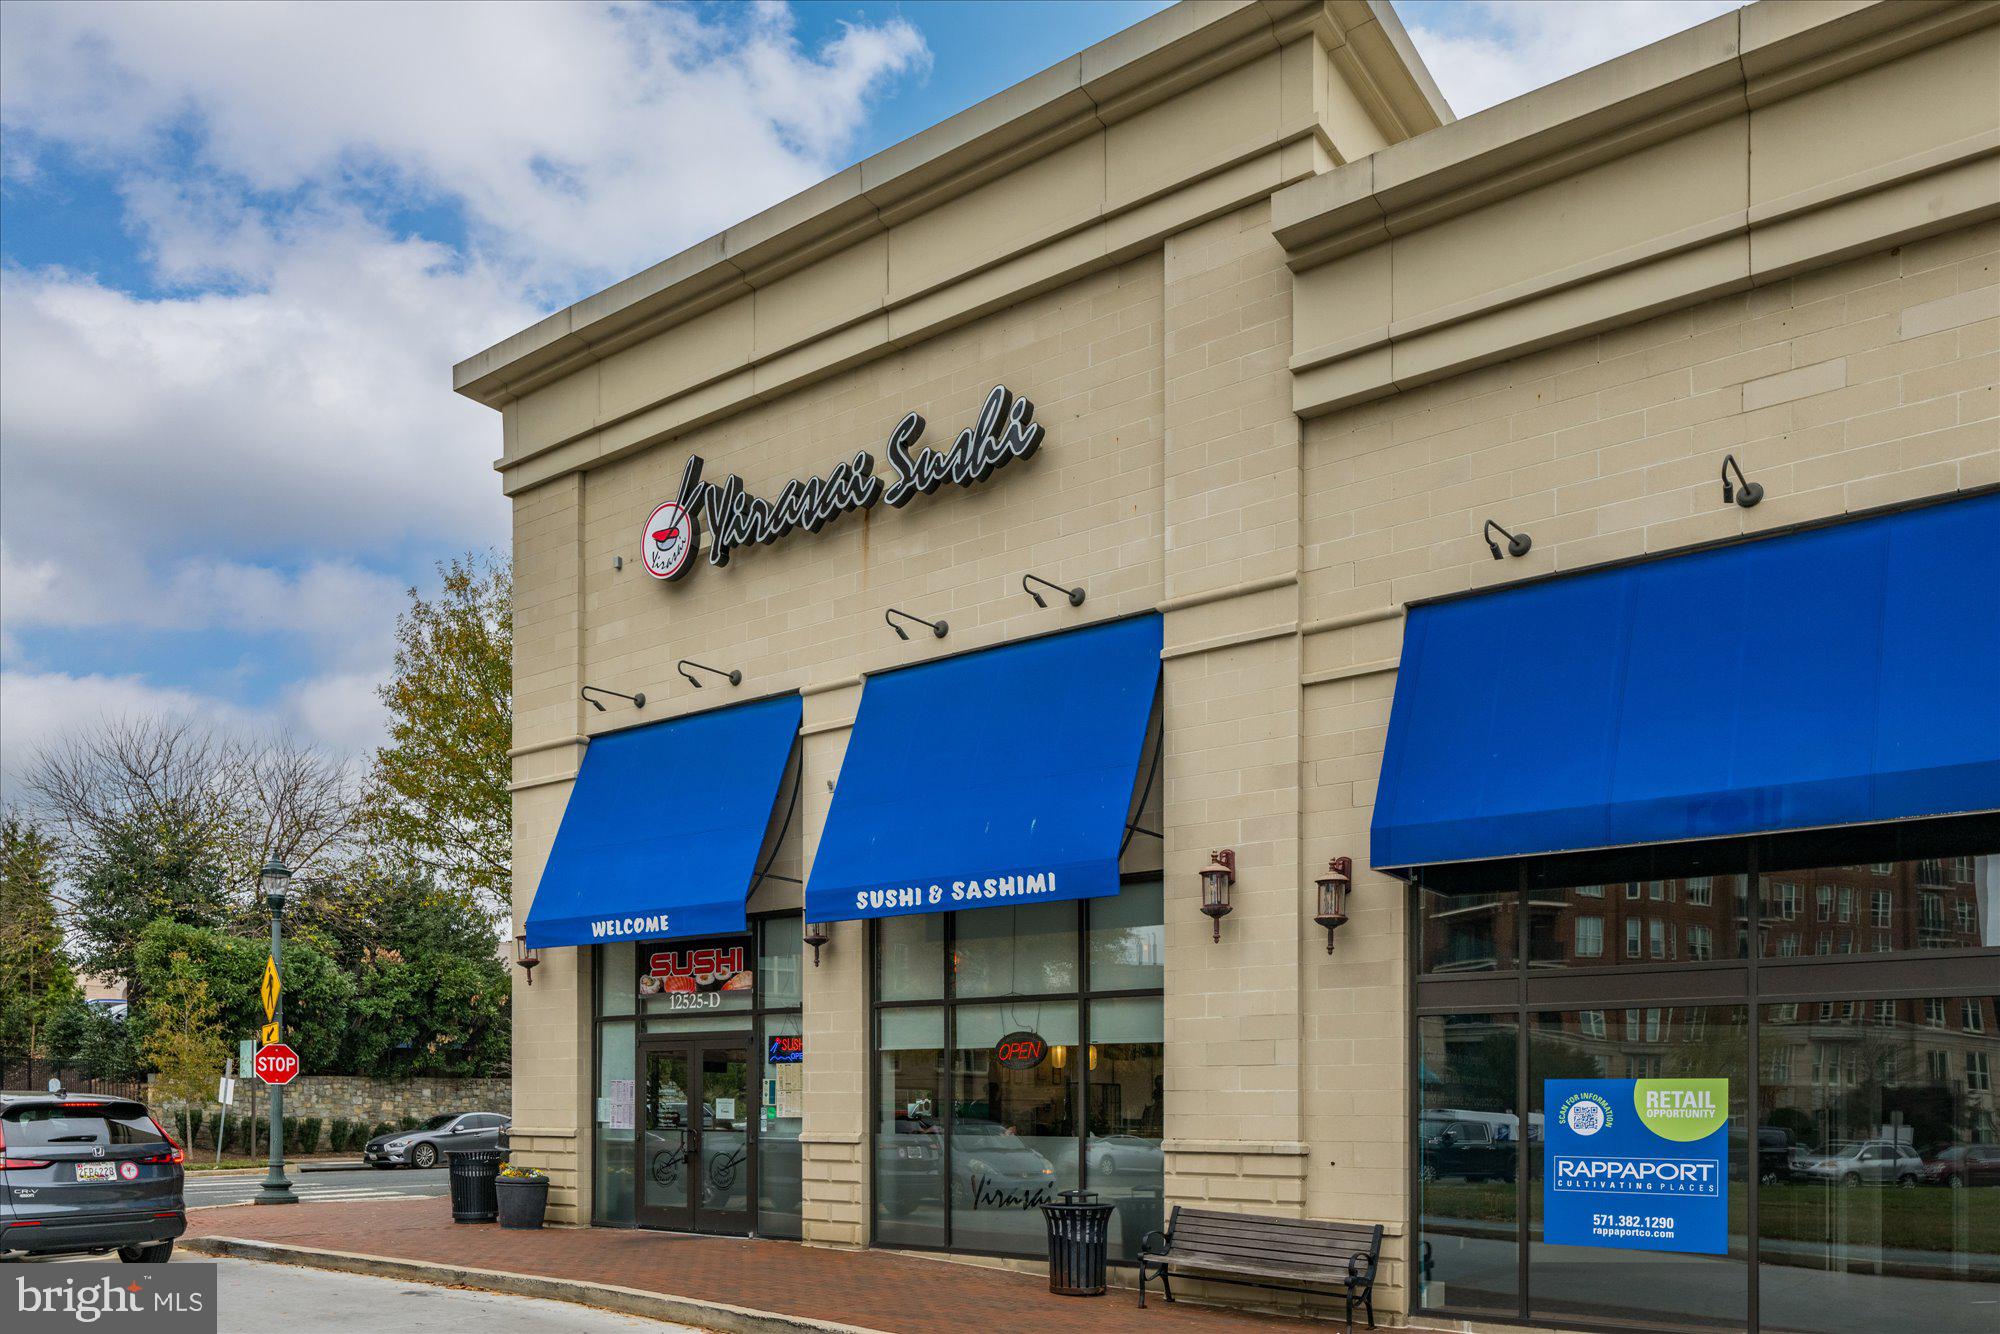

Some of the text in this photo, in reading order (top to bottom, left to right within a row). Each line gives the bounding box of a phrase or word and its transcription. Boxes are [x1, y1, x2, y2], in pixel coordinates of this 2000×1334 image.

[704, 384, 1043, 566] Yirasai Sushi
[856, 872, 1055, 909] SUSHI & SASHIMI
[591, 915, 669, 938] WELCOME
[650, 947, 743, 978] SUSHI
[669, 992, 720, 1009] 12525-D
[781, 1038, 803, 1051] SUSH
[999, 1041, 1041, 1060] OPEN
[257, 1056, 296, 1072] STOP
[791, 1052, 804, 1060] OPE
[1646, 1091, 1716, 1108] RETAIL
[1558, 1092, 1614, 1128] SCAN FOR INFORMATION
[1646, 1109, 1715, 1118] OPPORTUNITY
[1558, 1160, 1714, 1181] RAPPAPORT
[1557, 1179, 1714, 1192] CULTIVATING PLACES
[1593, 1214, 1674, 1229] 571.382.1290
[1593, 1227, 1674, 1239] rappaportco.com
